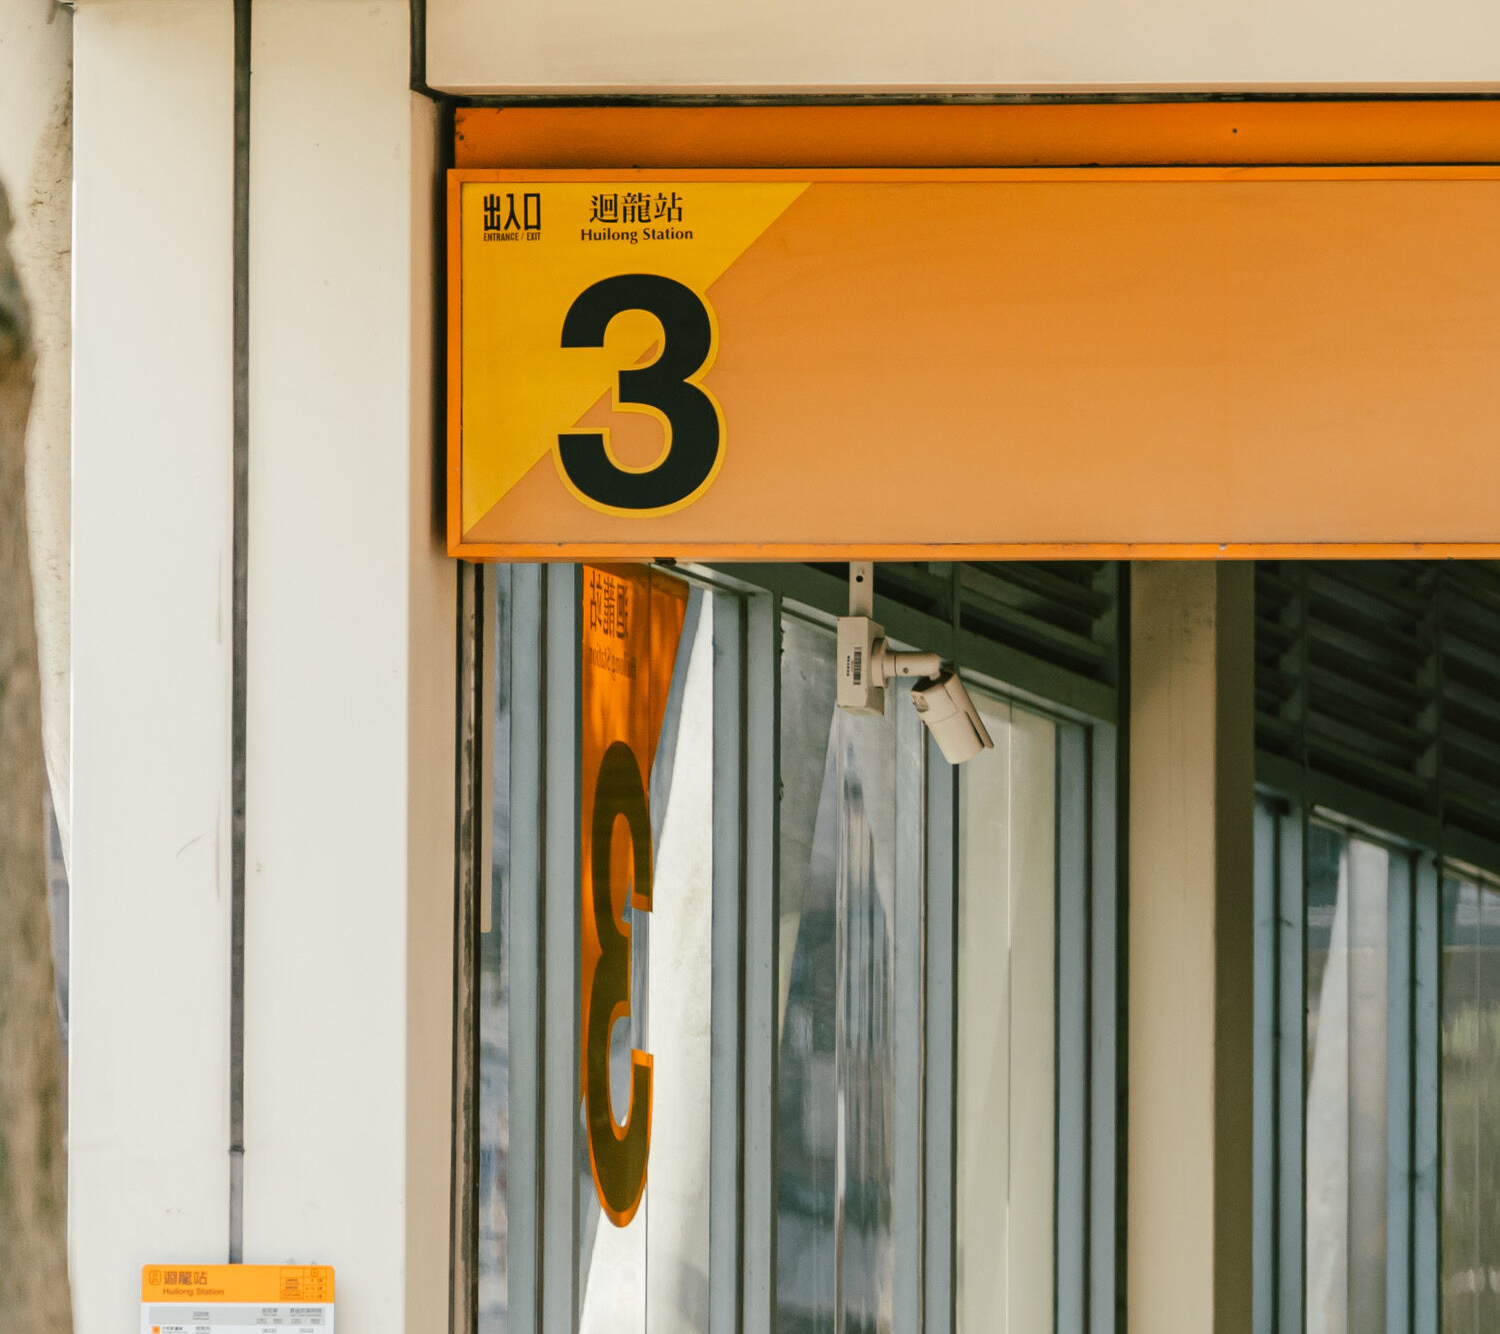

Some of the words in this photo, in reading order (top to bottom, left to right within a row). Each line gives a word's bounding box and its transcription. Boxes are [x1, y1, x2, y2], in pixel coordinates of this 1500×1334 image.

[483, 193, 541, 231] 出入口
[589, 191, 684, 224] 迴龍站
[483, 232, 518, 242] ENTRANCE
[526, 232, 541, 242] EXIT
[580, 228, 638, 245] Huilong
[643, 227, 693, 241] Station
[558, 273, 720, 509] 3
[163, 1270, 207, 1285] 迴龍站
[162, 1288, 194, 1297] Huilong
[196, 1288, 225, 1296] Station
